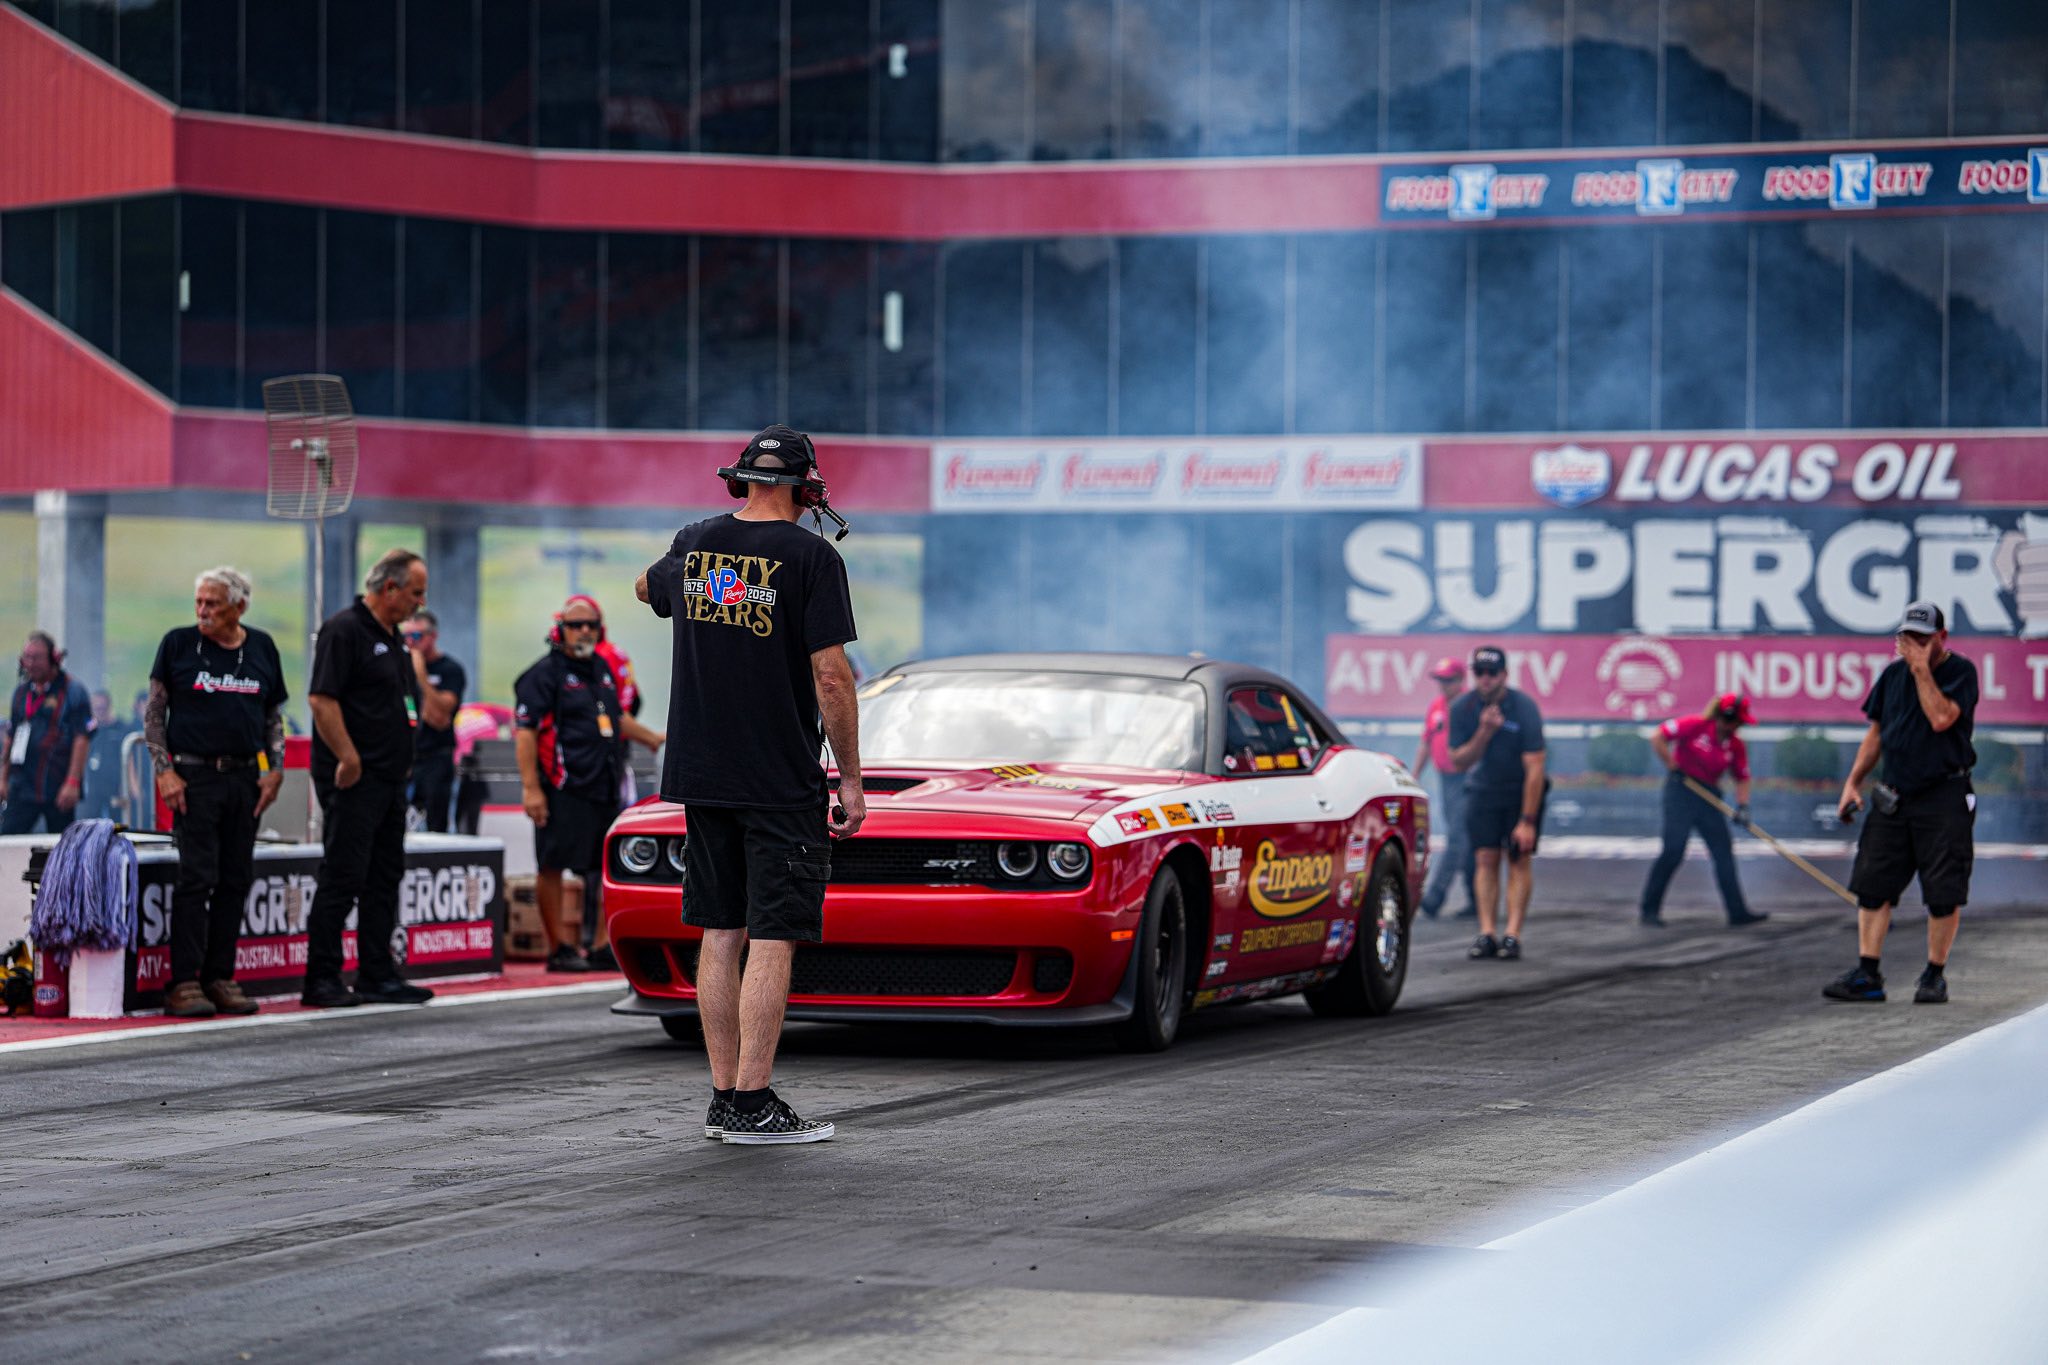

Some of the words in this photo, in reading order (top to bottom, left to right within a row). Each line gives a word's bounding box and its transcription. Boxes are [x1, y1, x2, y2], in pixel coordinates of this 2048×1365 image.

[1386, 176, 1452, 211] FOOD
[1491, 174, 1551, 208] CITY
[1572, 171, 1638, 207] FOOD
[1679, 168, 1739, 204] CITY
[1762, 165, 1832, 201] FOOD
[1874, 163, 1933, 197] CITY
[1958, 160, 2029, 195] FOOD
[1614, 443, 1840, 502] LUCAS
[1851, 443, 1963, 502] OIL
[684, 551, 783, 588] FIFTY
[685, 581, 704, 592] 1975
[707, 567, 738, 605] VP
[747, 588, 773, 603] 2025
[724, 588, 747, 601] Racing
[684, 594, 773, 637] YEARS
[1329, 650, 1430, 695] ATV
[923, 859, 977, 871] SRT
[1248, 840, 1332, 917] Empaco
[235, 944, 285, 970] DUSTRIAL
[414, 930, 467, 954] INDUSTRIAL
[468, 926, 493, 950] TIRES
[137, 953, 163, 980] ATV
